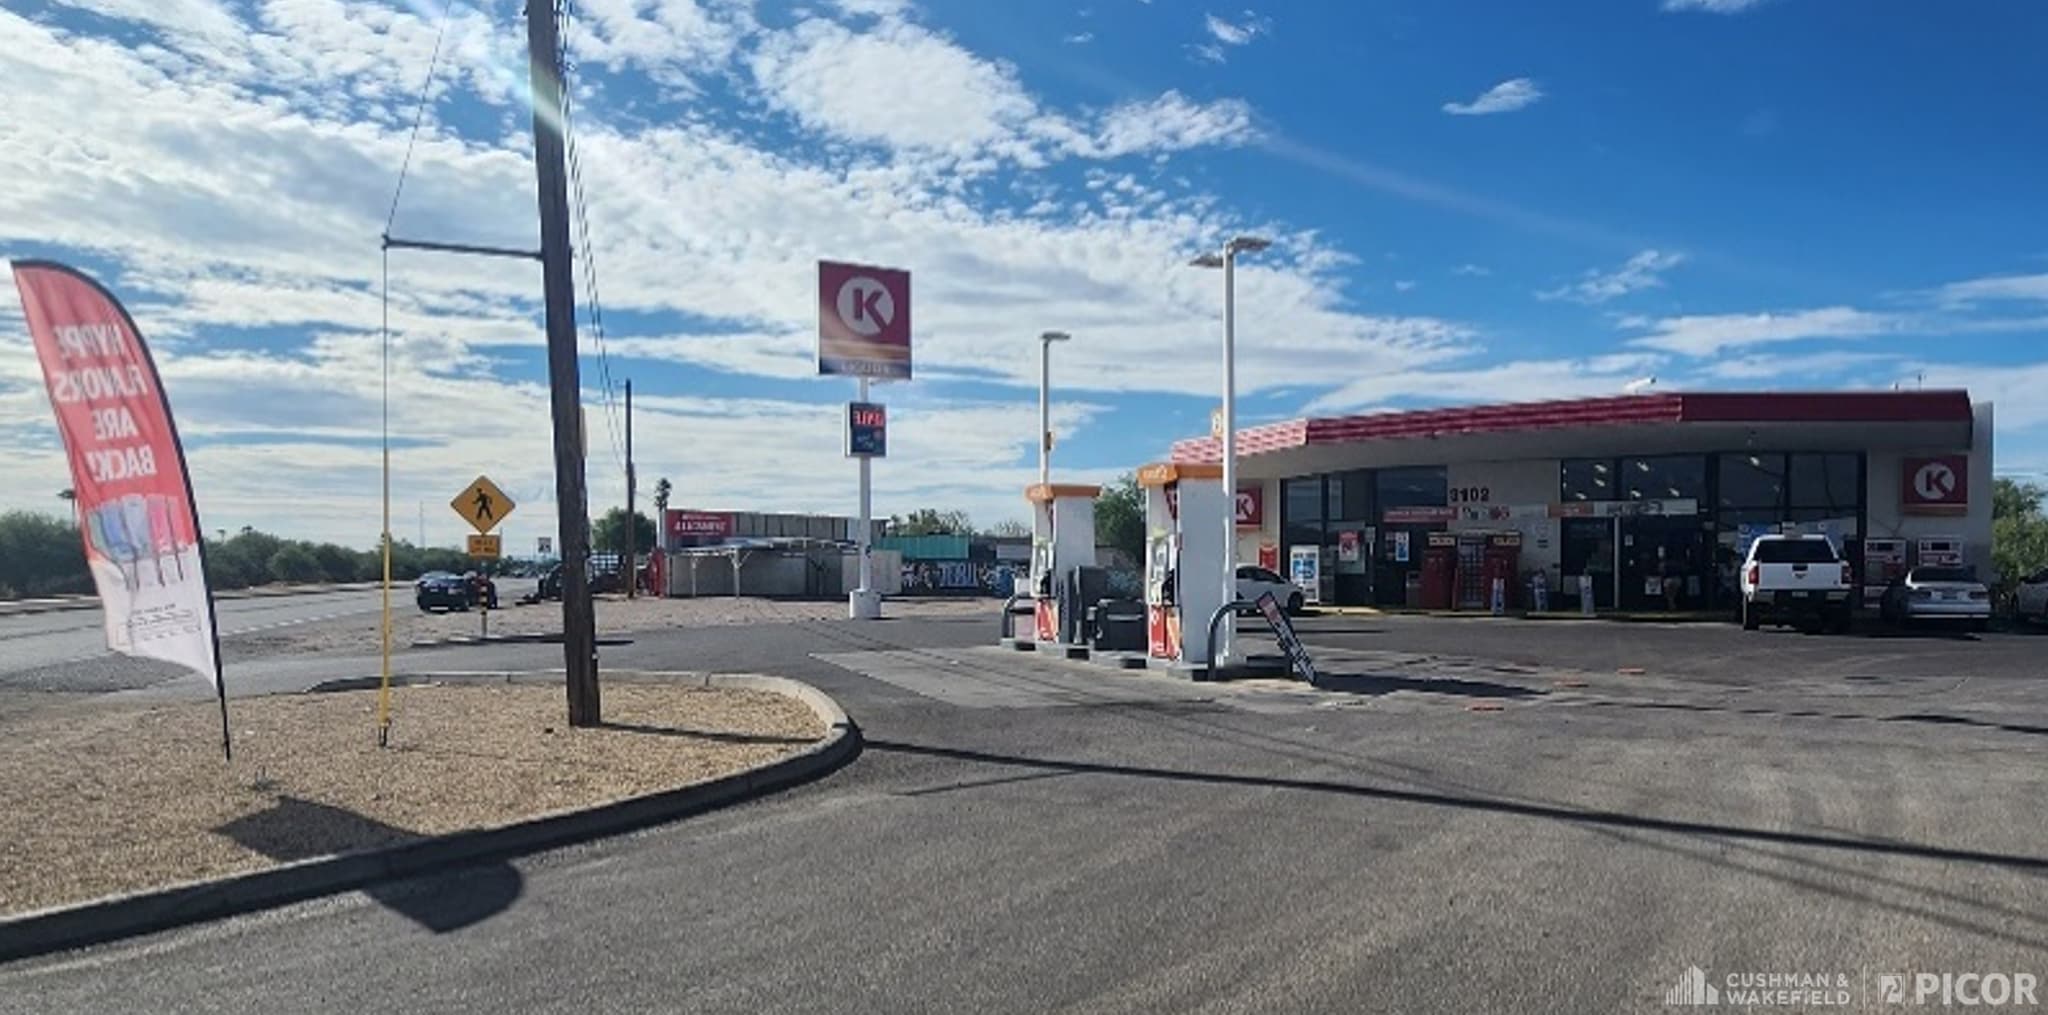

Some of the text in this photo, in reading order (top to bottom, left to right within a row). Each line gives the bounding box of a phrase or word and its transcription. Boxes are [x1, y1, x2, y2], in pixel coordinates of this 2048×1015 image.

[851, 286, 891, 333] K
[1924, 469, 1951, 494] K
[1450, 487, 1490, 502] 3102
